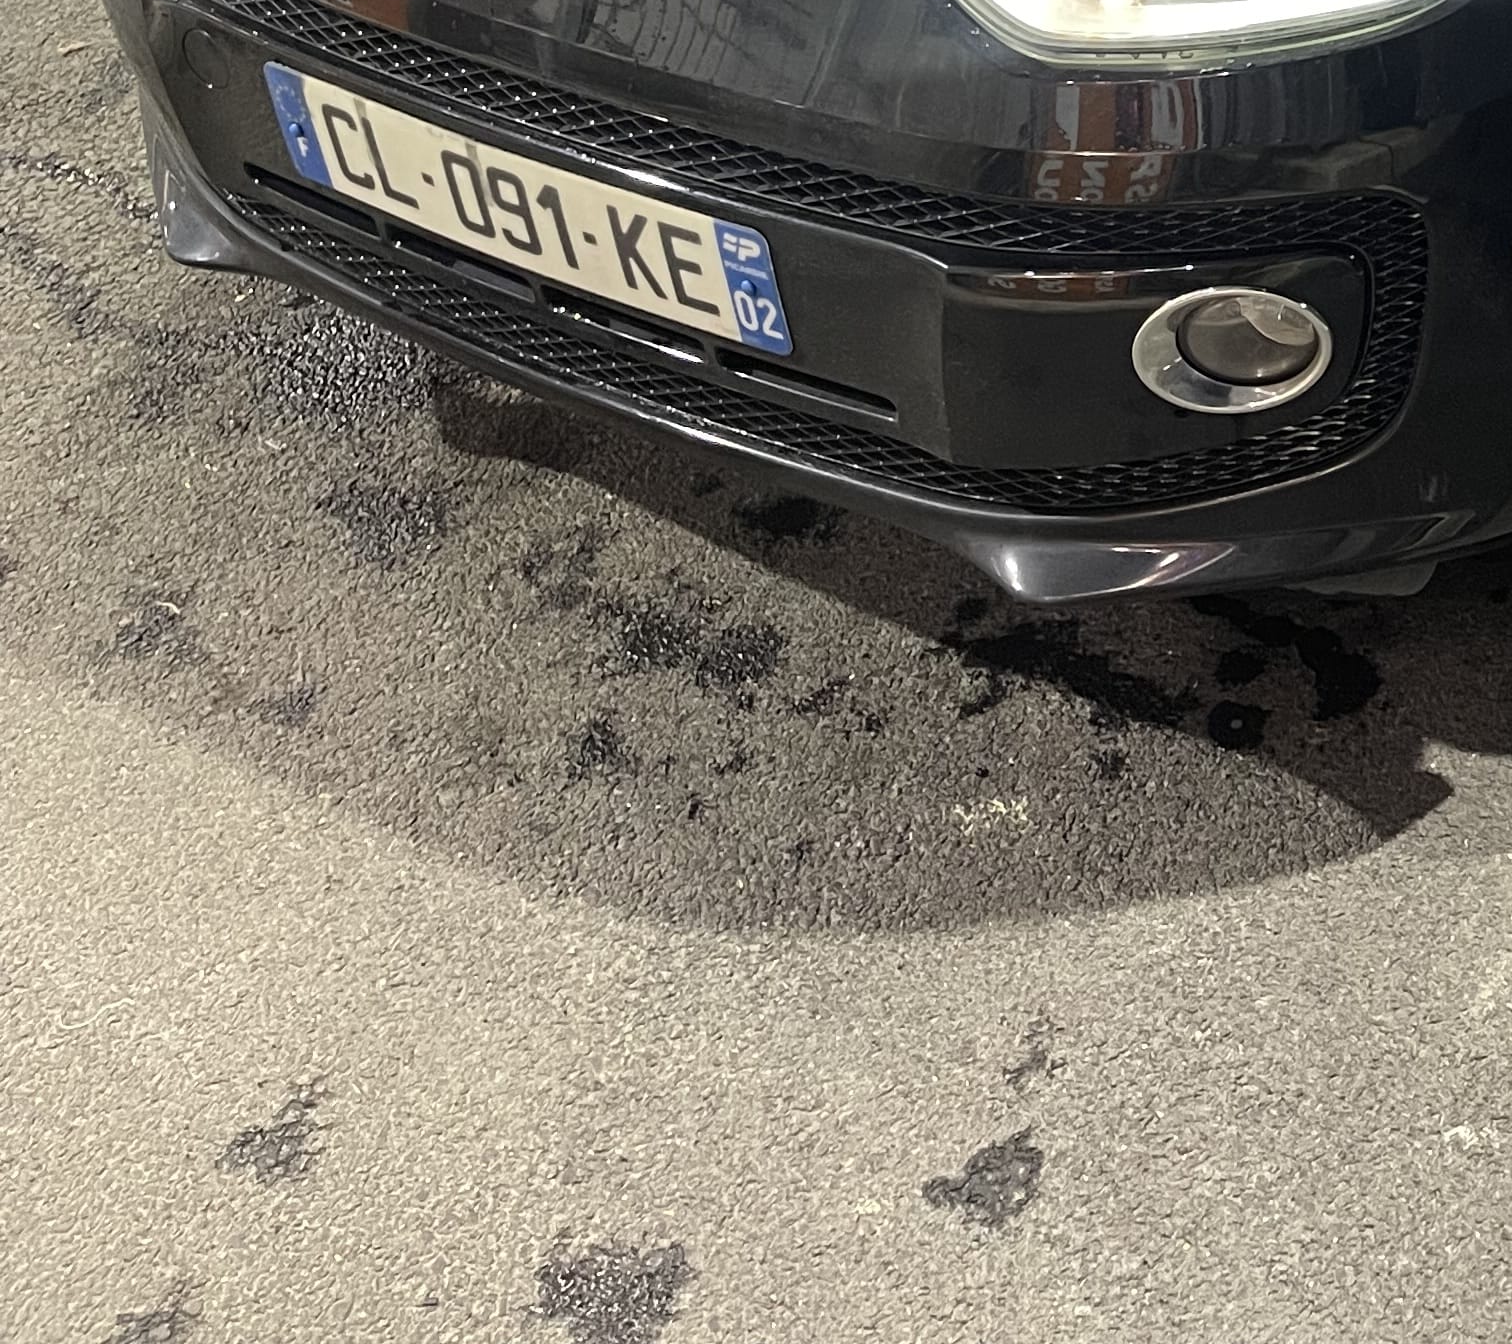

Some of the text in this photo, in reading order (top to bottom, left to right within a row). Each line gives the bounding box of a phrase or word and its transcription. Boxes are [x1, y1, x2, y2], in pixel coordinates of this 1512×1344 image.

[296, 136, 309, 158] F
[321, 103, 720, 318] CL-091-KE
[733, 290, 784, 340] 02
